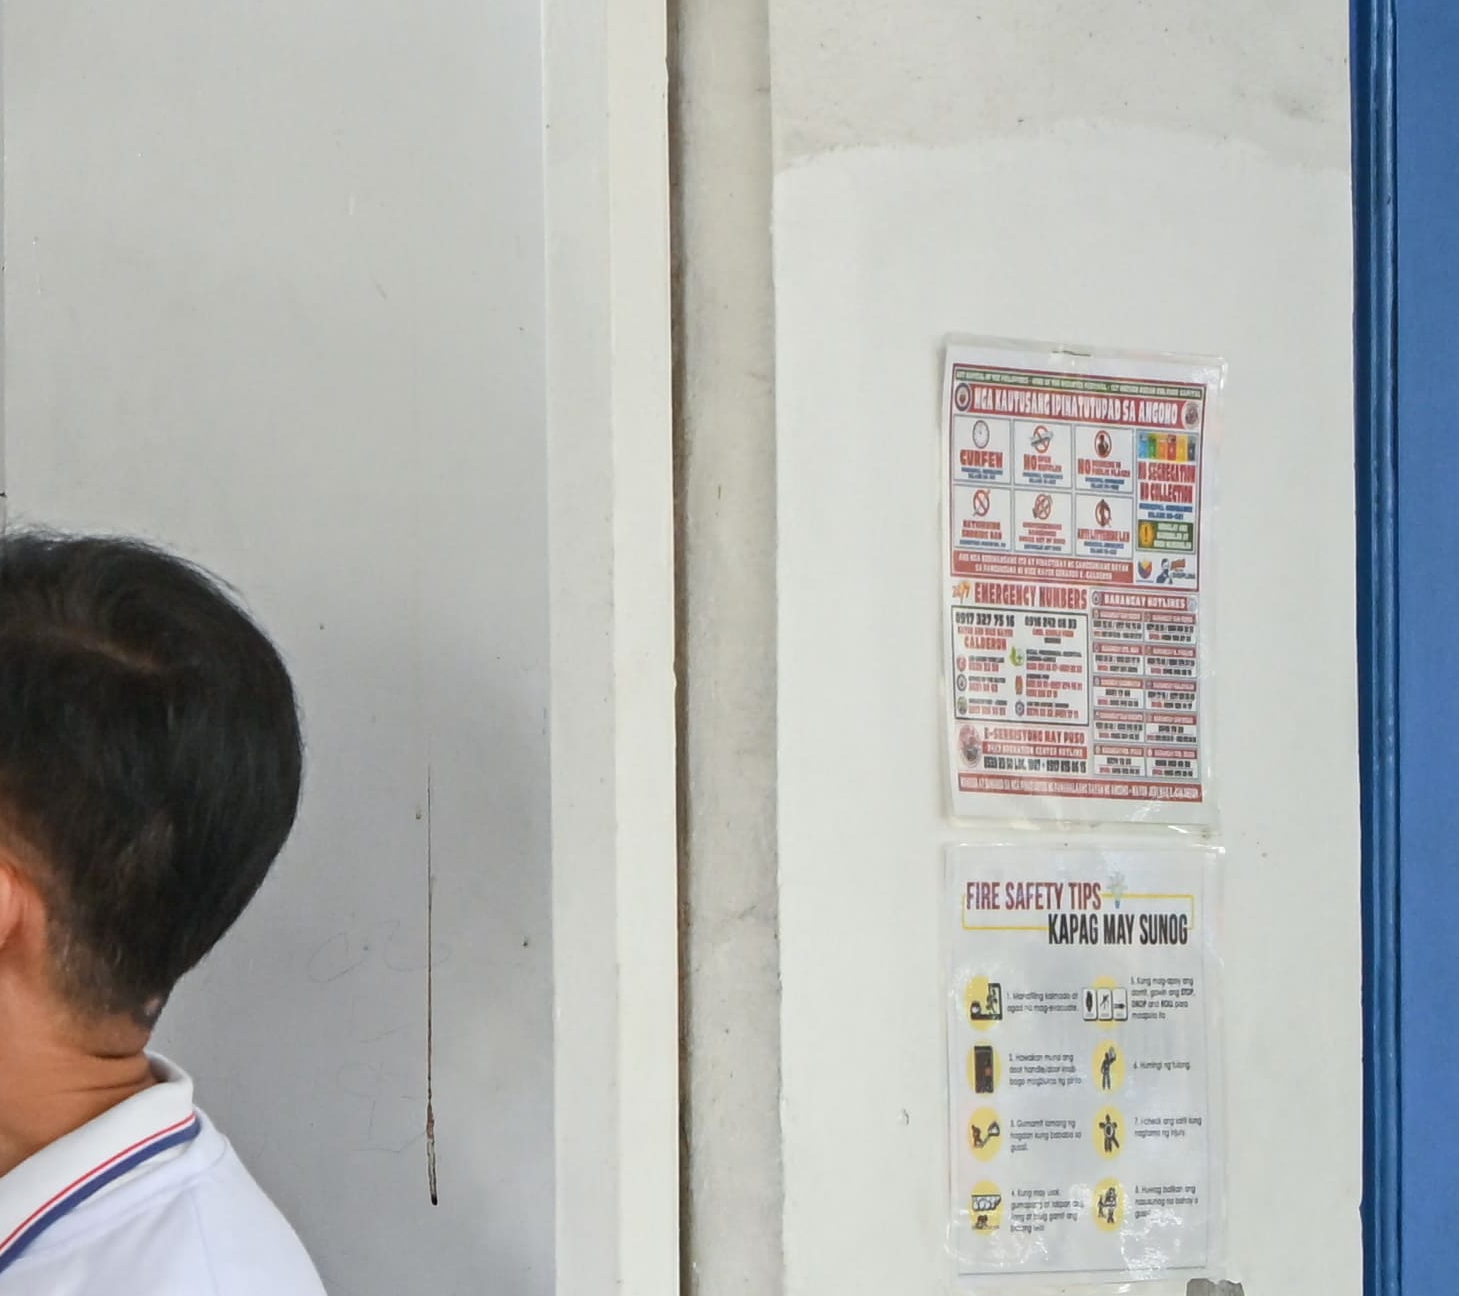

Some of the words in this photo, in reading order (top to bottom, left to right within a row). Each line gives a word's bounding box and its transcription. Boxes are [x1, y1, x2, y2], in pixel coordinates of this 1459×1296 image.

[995, 388, 1050, 416] KAUTUSANG
[1123, 399, 1136, 422] SA
[1138, 401, 1178, 424] ANGONO
[975, 582, 1036, 607] EMERGENCY
[1039, 585, 1087, 610] NUMBERS
[966, 882, 1000, 910] FIRE
[1005, 882, 1063, 910] SAFETY
[1068, 882, 1102, 910] TIPS
[1048, 913, 1098, 945] KAPAG
[1103, 913, 1135, 945] MAY
[1139, 913, 1188, 945] SUNOG
